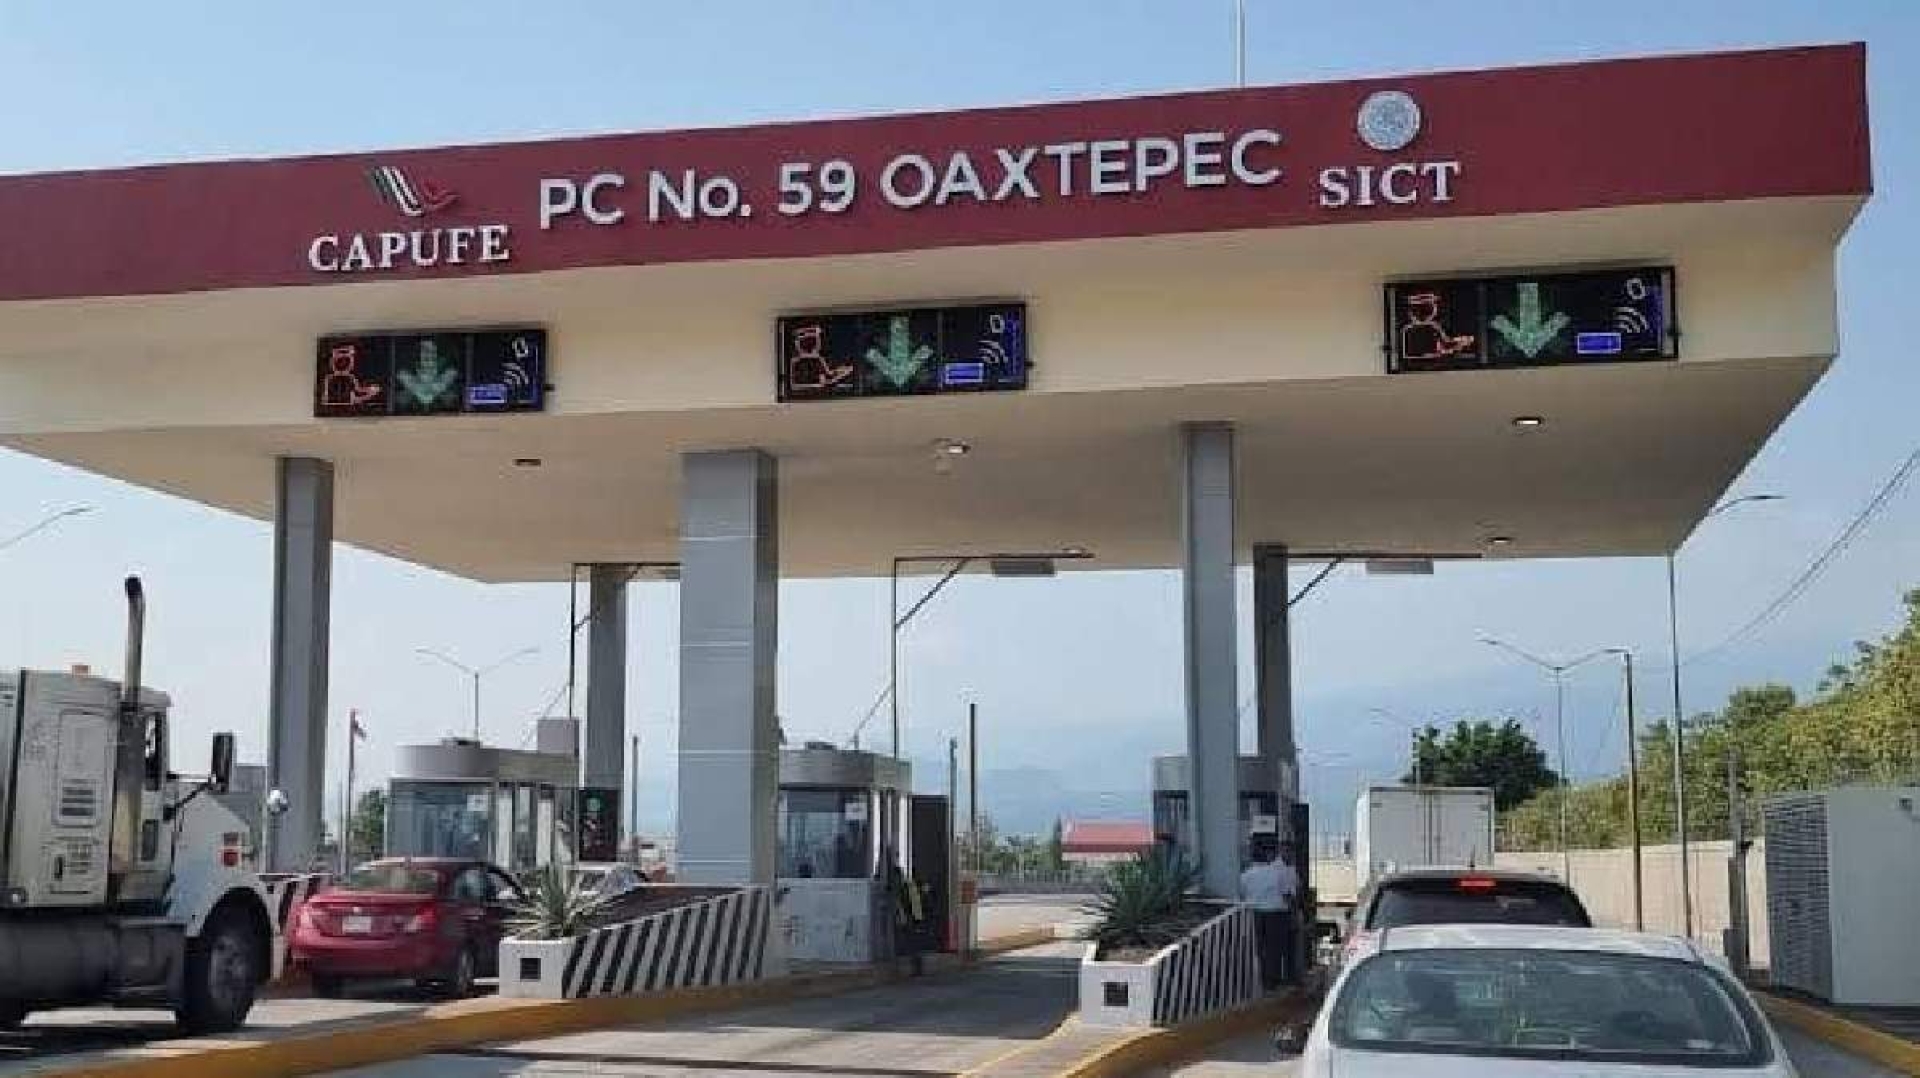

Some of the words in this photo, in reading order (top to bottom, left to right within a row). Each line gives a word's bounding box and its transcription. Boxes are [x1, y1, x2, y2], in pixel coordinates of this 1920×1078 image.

[540, 173, 626, 231] PC
[648, 168, 751, 223] No.
[778, 160, 857, 215] 59
[881, 129, 1282, 208] OAXTEPEC
[1318, 160, 1461, 208] SICT
[308, 224, 510, 272] CAPUFE
